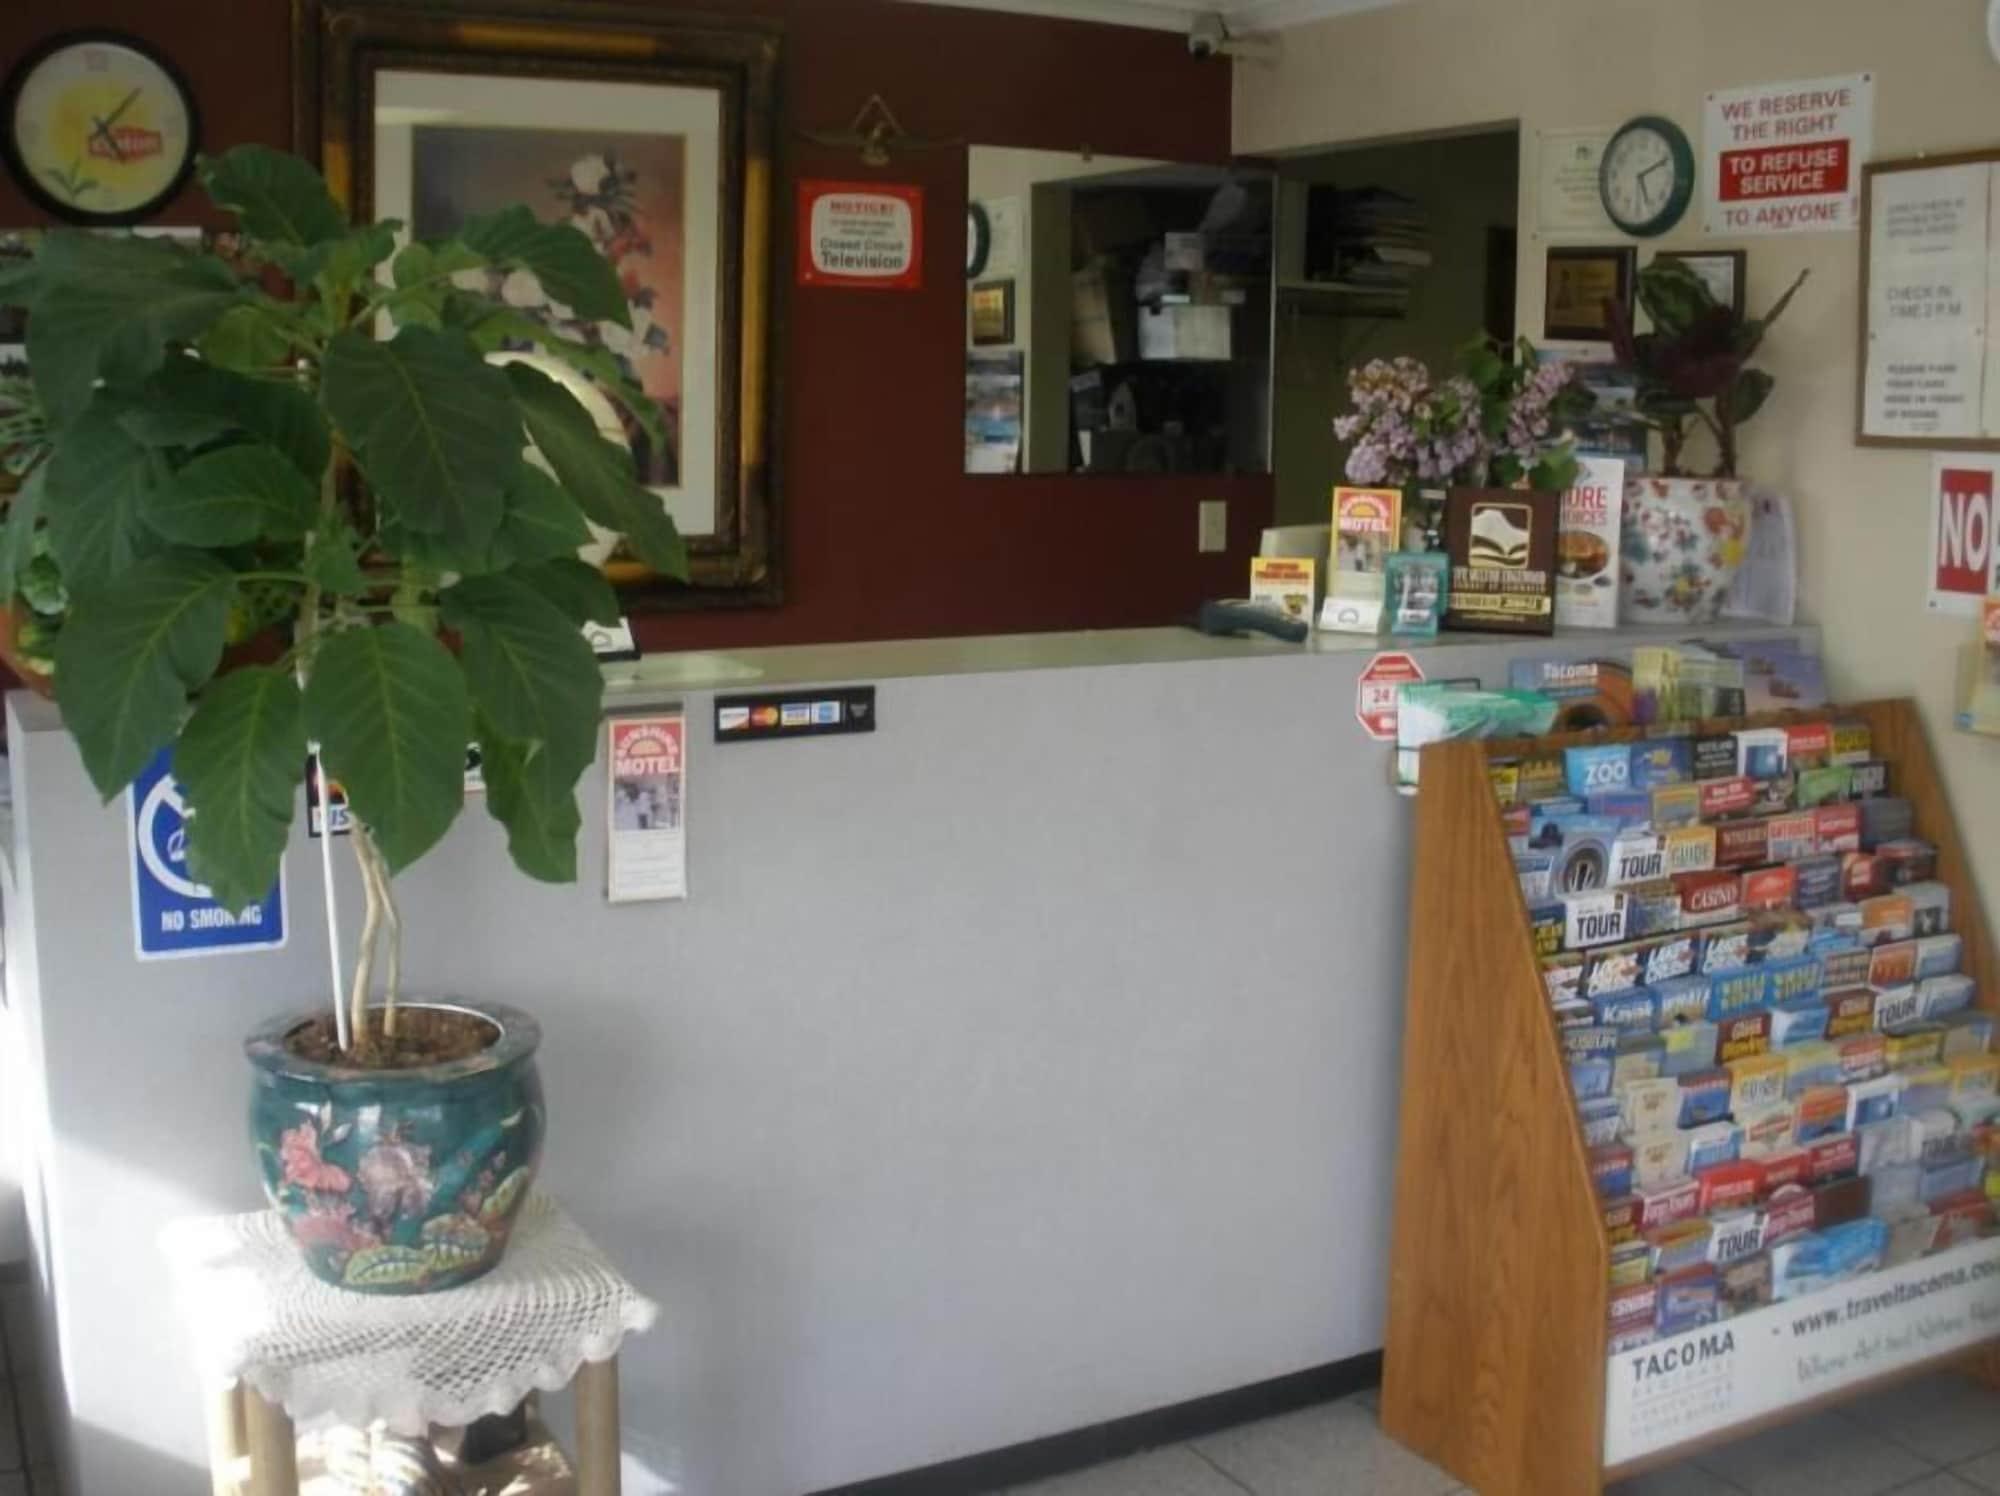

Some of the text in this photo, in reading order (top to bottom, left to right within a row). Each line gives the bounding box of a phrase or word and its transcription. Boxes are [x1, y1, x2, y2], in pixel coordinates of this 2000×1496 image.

[1721, 89, 1851, 121] WE RESERVE
[1732, 113, 1837, 141] THE RIGHT
[1730, 147, 1839, 176] TO REFUSE
[1740, 170, 1825, 195] SERVICE
[1724, 208, 1750, 227] TO
[1756, 202, 1840, 224] ANYONE
[821, 250, 905, 270] Television
[1941, 491, 1988, 572] NO
[1543, 663, 1599, 680] Tacoma
[616, 757, 680, 776] MOTEL
[1586, 763, 1629, 785] ZOO
[1619, 853, 1663, 881] TOUR
[161, 905, 262, 931] NO SMOKNG
[1576, 911, 1622, 941] TOUR
[1878, 998, 1918, 1026] TOUR
[1717, 1229, 1762, 1259] TOUR
[1632, 1330, 1736, 1383] TACOMA
